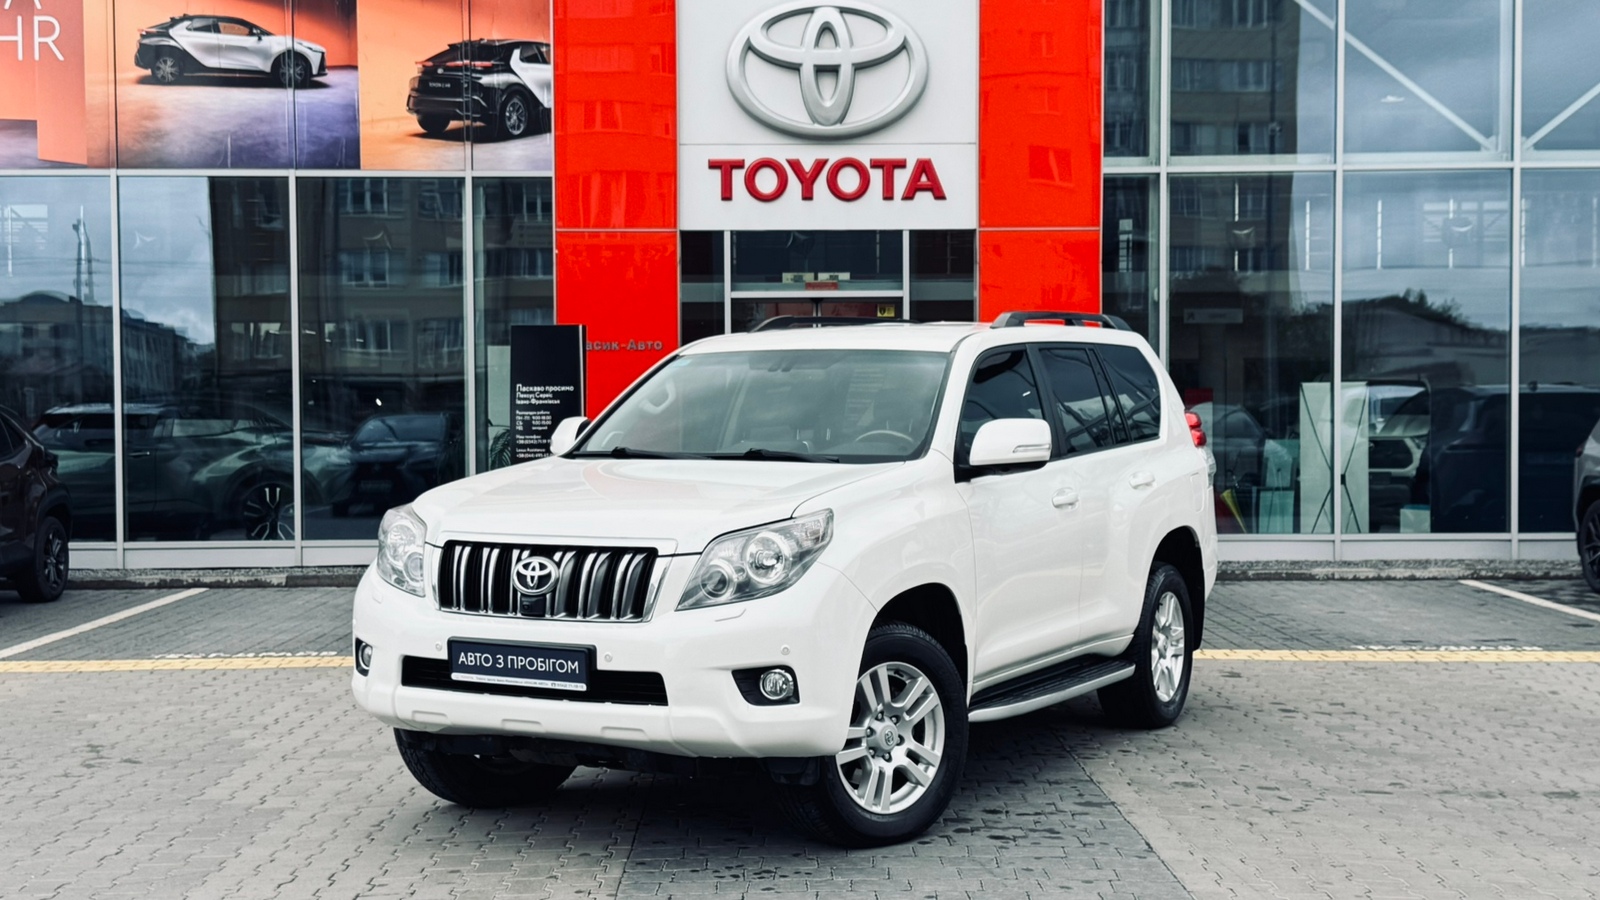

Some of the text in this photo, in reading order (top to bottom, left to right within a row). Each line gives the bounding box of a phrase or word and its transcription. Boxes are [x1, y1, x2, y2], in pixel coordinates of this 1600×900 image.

[708, 157, 947, 202] TOYOTA
[458, 652, 579, 674] АВТО З ПРОБІГОМ
